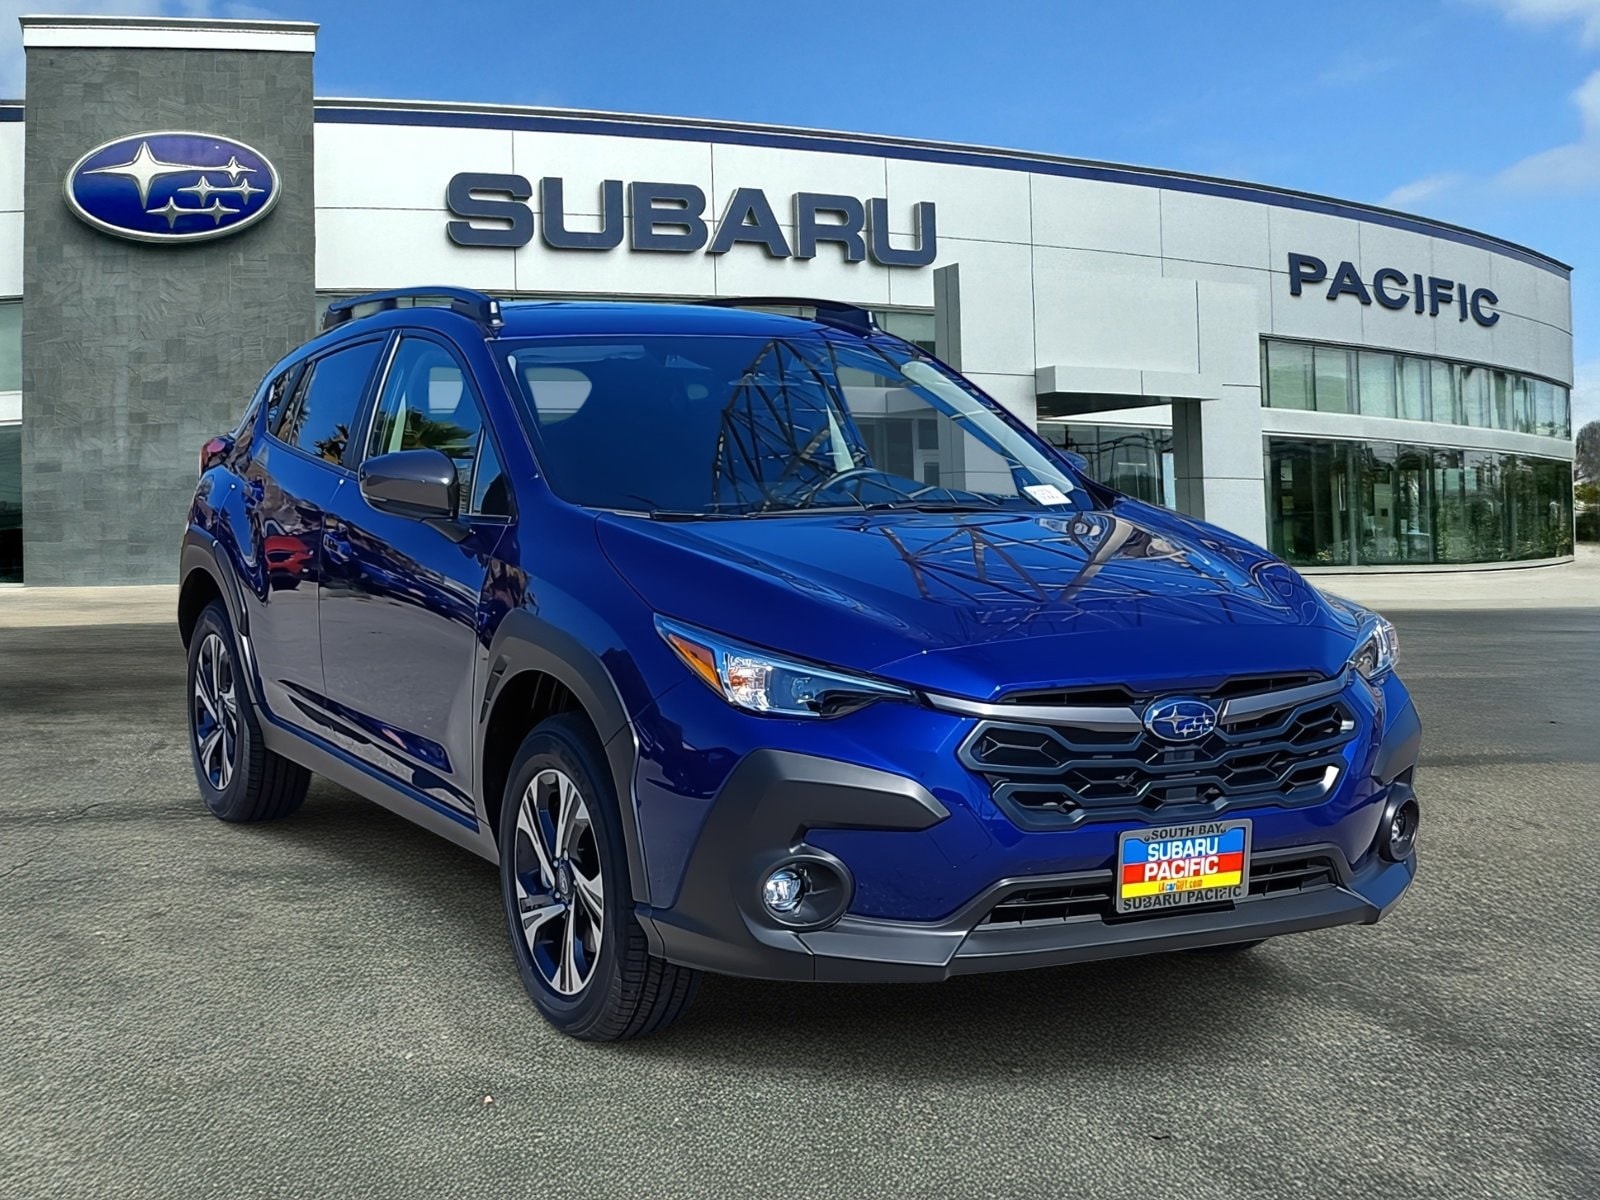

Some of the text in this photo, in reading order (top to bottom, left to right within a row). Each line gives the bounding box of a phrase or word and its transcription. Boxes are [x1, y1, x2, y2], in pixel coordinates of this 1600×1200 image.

[446, 172, 938, 267] SUBARU
[1288, 252, 1500, 327] PACIFIC
[1151, 823, 1223, 840] SOUTH BAY
[1147, 837, 1219, 861] SUBARU
[1144, 856, 1219, 881] PACIFIC
[1123, 886, 1242, 911] SUBARU PACIFIC
